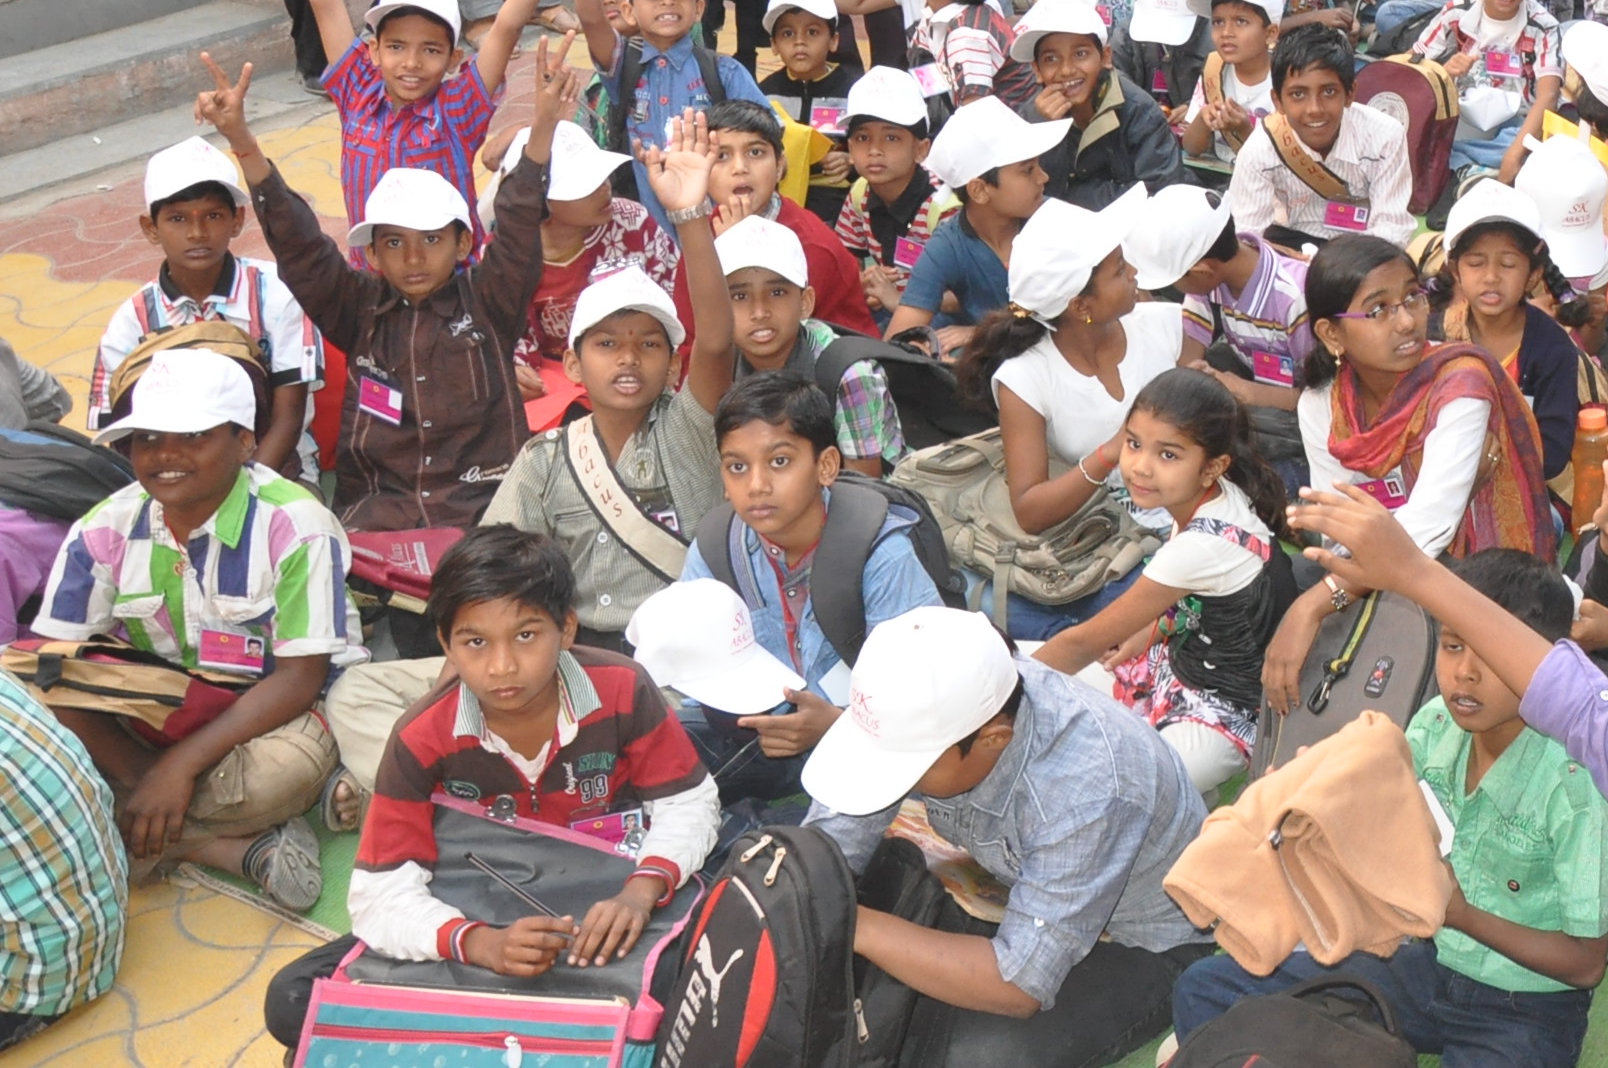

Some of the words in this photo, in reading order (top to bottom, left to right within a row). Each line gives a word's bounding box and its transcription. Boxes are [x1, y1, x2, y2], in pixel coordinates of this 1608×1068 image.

[1568, 199, 1589, 215] SK
[850, 686, 874, 716] SK
[564, 762, 573, 796] Original
[580, 774, 609, 804] 99
